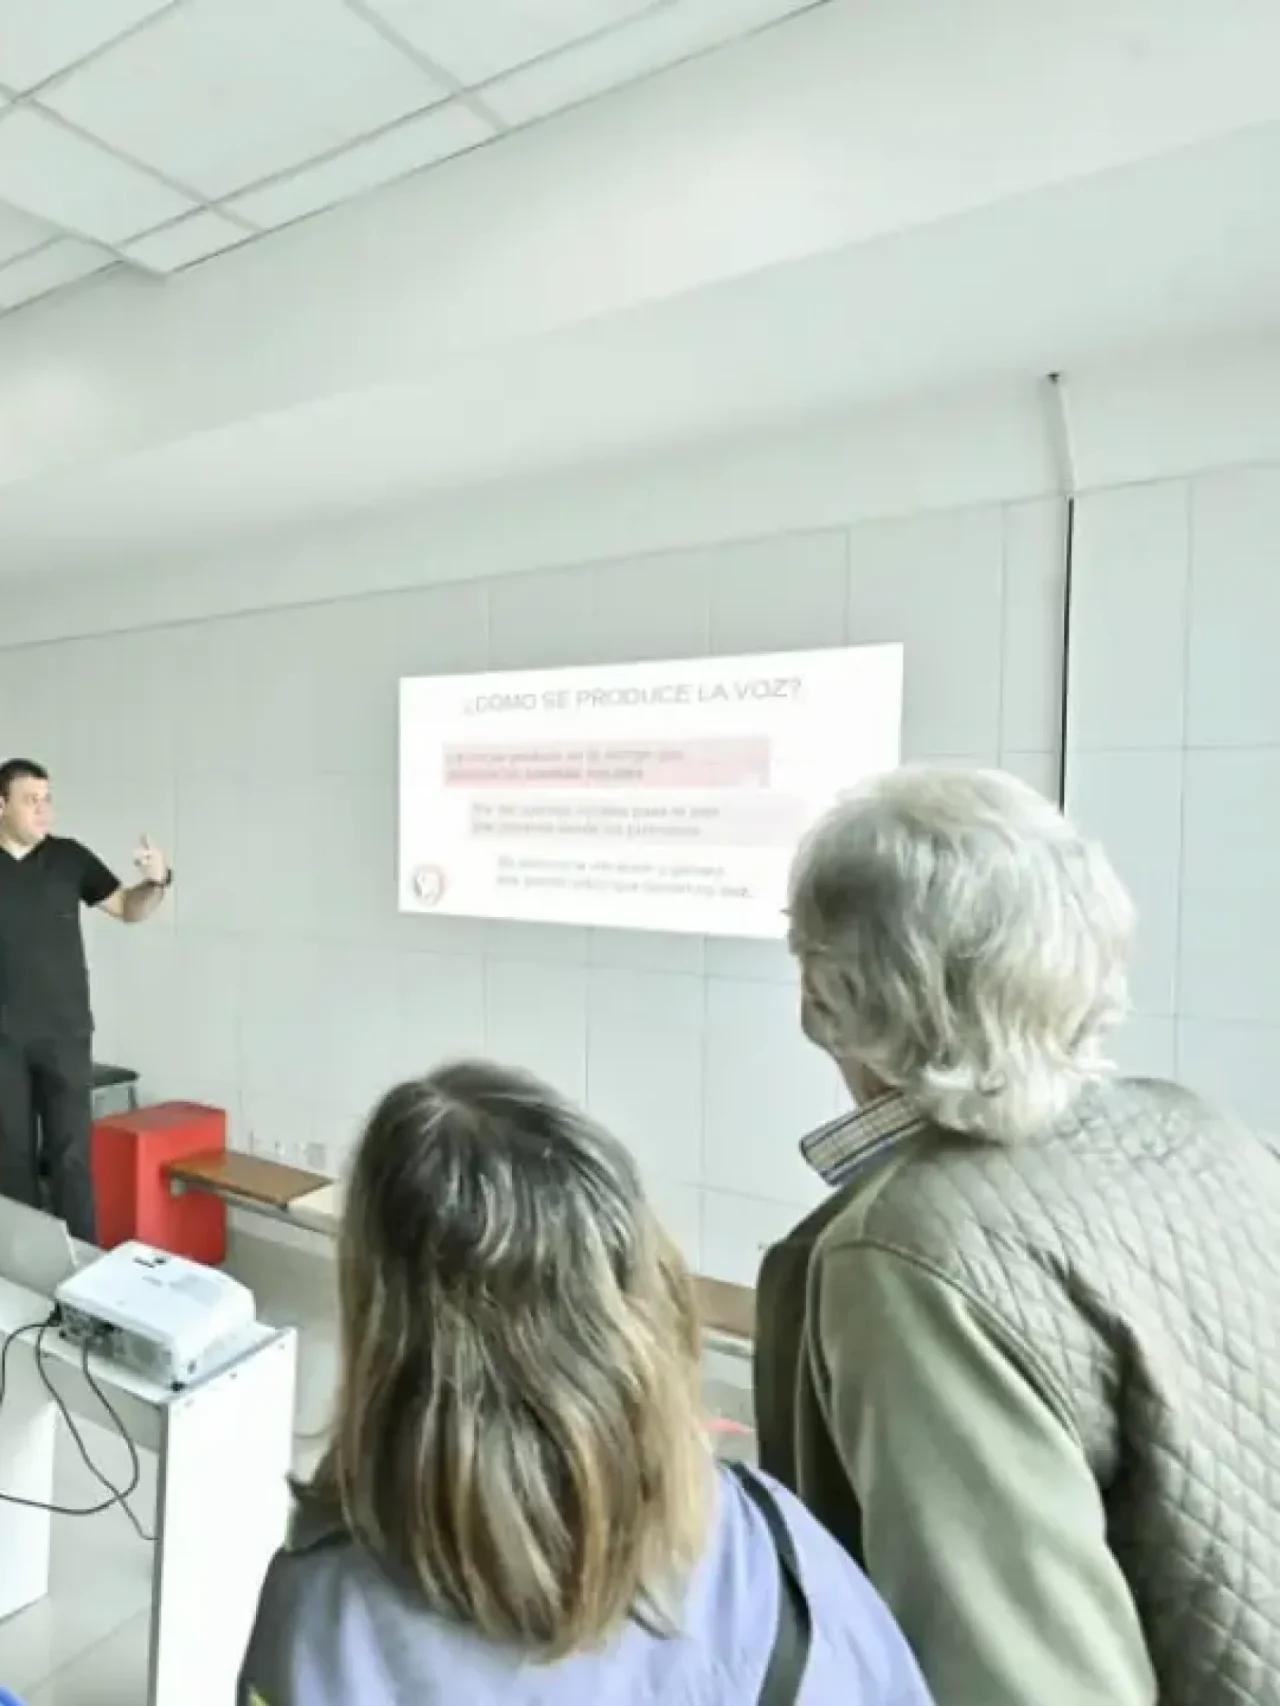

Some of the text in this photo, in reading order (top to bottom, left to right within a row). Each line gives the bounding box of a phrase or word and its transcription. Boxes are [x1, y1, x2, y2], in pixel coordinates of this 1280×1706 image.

[542, 689, 570, 710] SE
[576, 683, 693, 708] PRODUCE
[698, 680, 729, 702] LA
[732, 676, 803, 701] VOZ?
